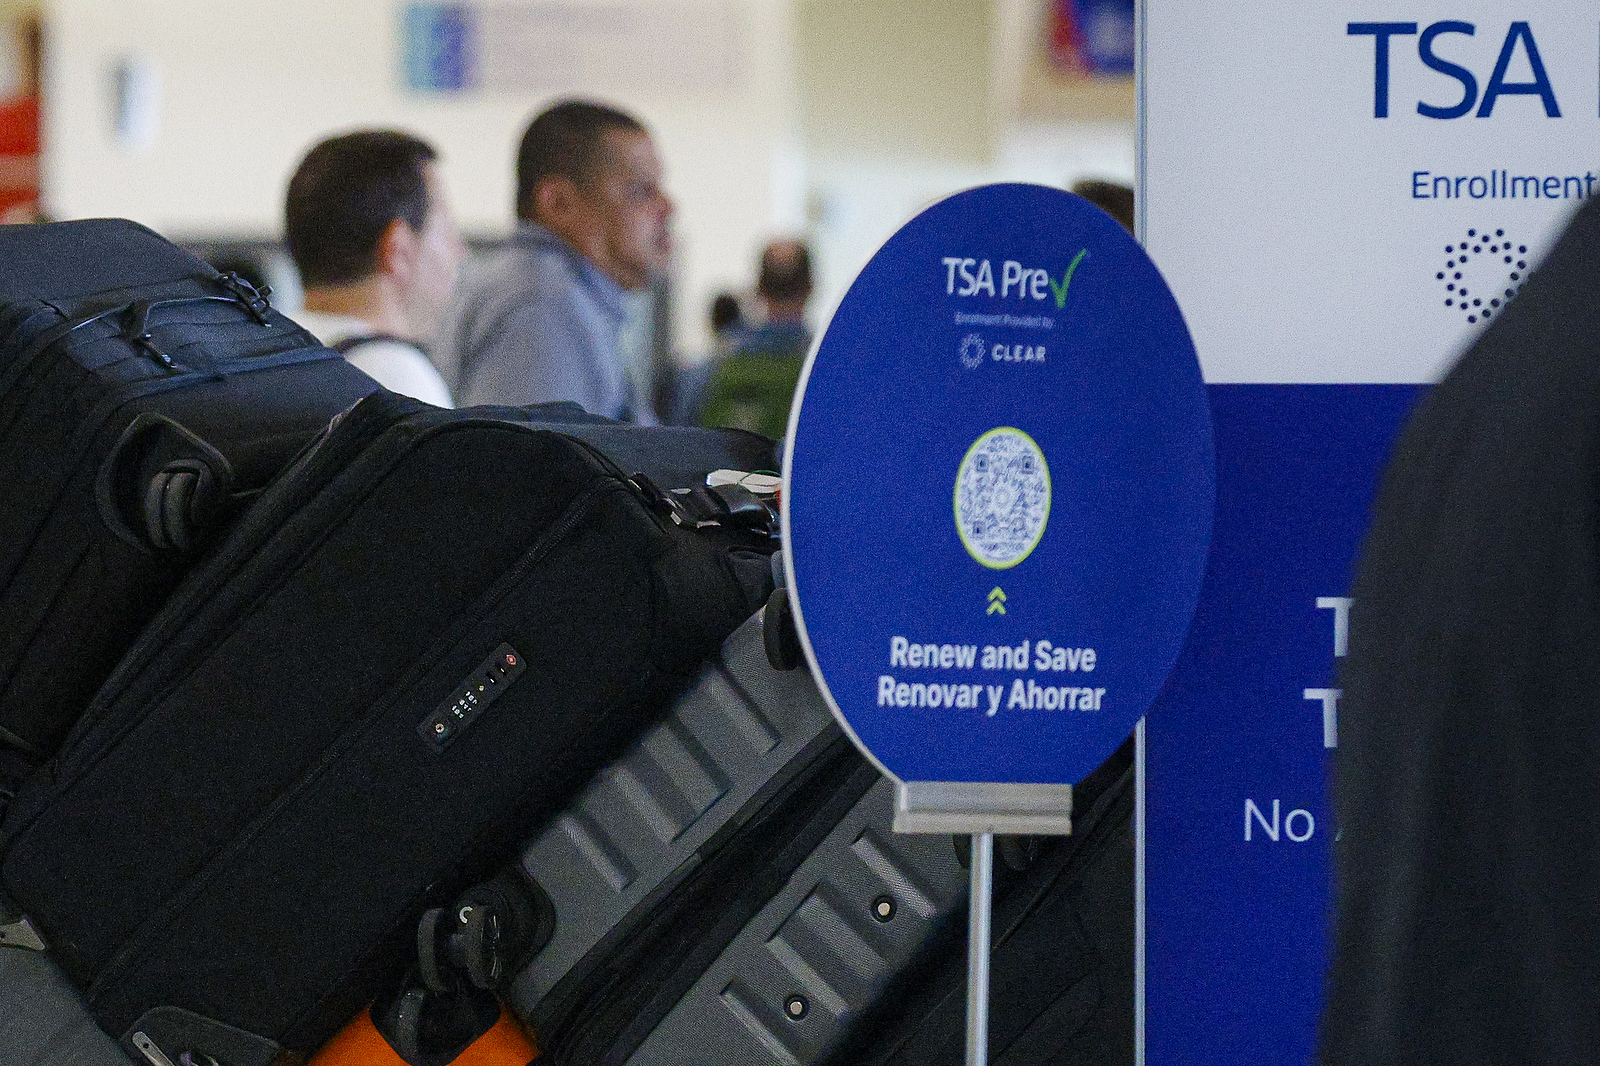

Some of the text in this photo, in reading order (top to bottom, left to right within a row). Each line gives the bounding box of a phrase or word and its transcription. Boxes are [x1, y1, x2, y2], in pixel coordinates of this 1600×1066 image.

[1347, 20, 1562, 119] TSA
[1412, 169, 1597, 199] Enrollment
[941, 257, 1049, 300] TSA Pre
[991, 344, 1046, 363] CLEAR
[890, 636, 1097, 672] Renew and Save
[877, 675, 1107, 717] Renovar y Ahorrar
[1244, 799, 1315, 842] No
